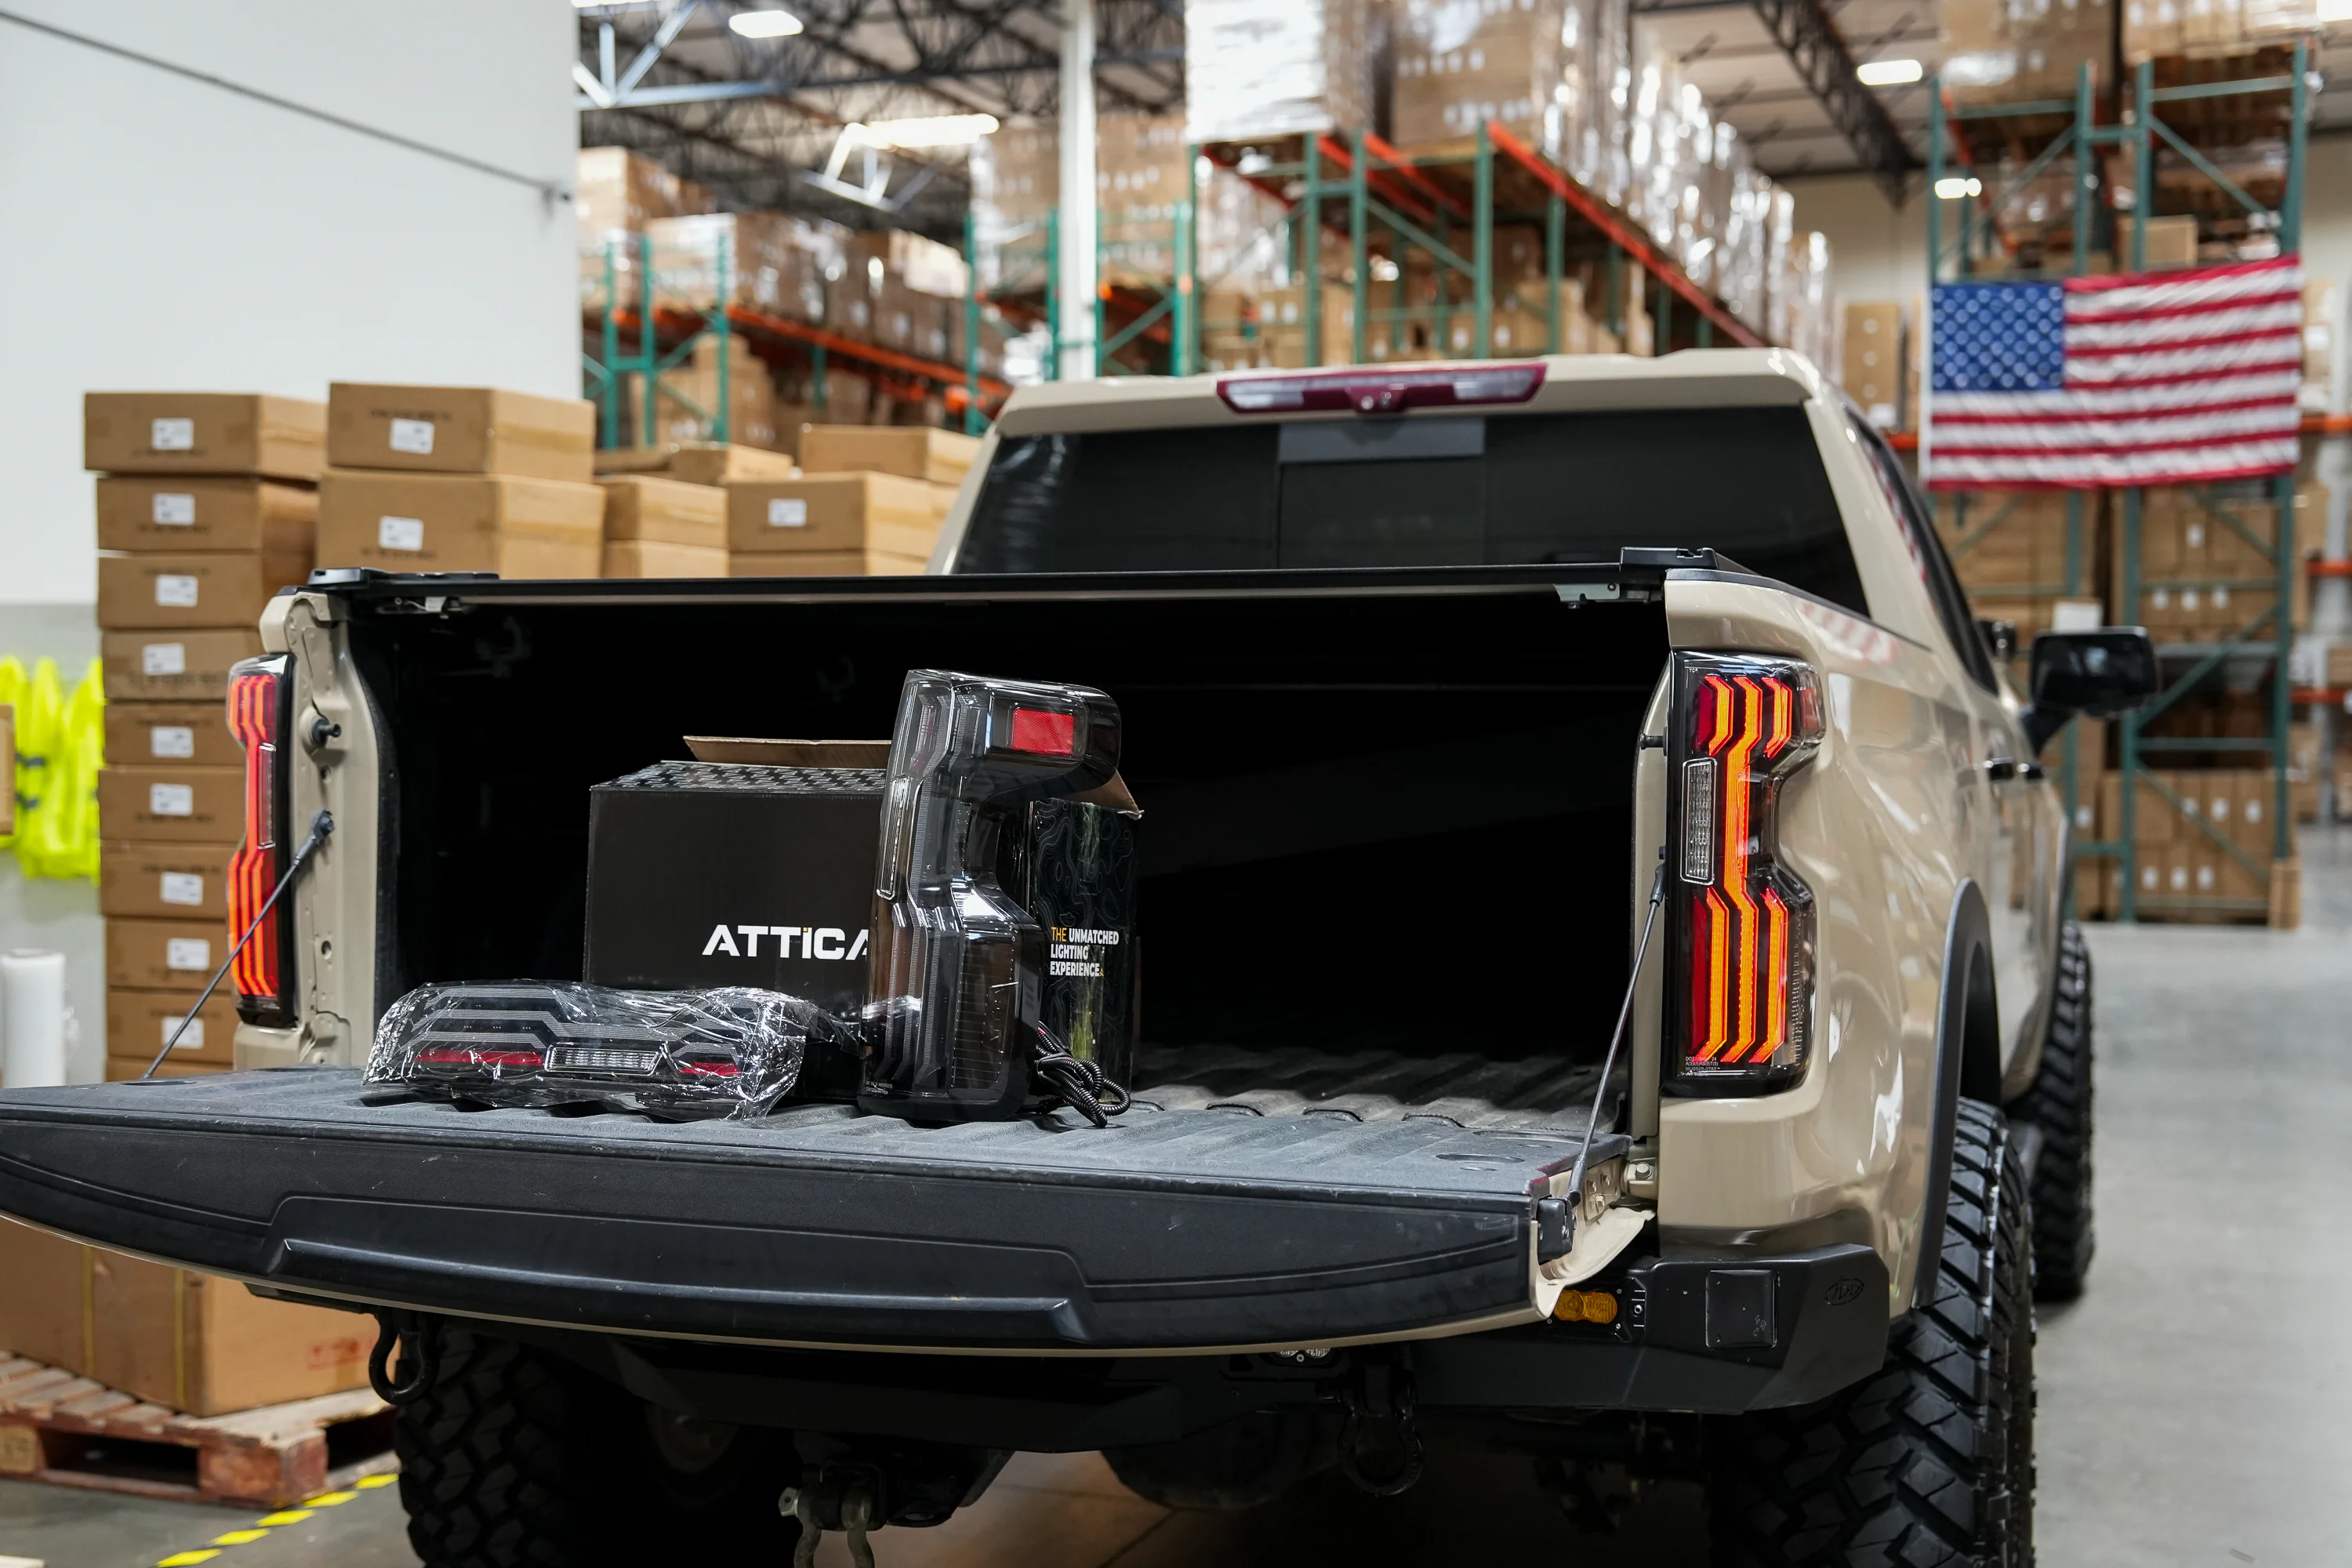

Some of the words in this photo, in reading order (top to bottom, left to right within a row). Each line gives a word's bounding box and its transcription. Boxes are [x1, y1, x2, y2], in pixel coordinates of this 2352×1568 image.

[1051, 927, 1067, 942] THE
[1069, 928, 1119, 945] UNMATCHED
[1051, 944, 1089, 960] LIGHTING
